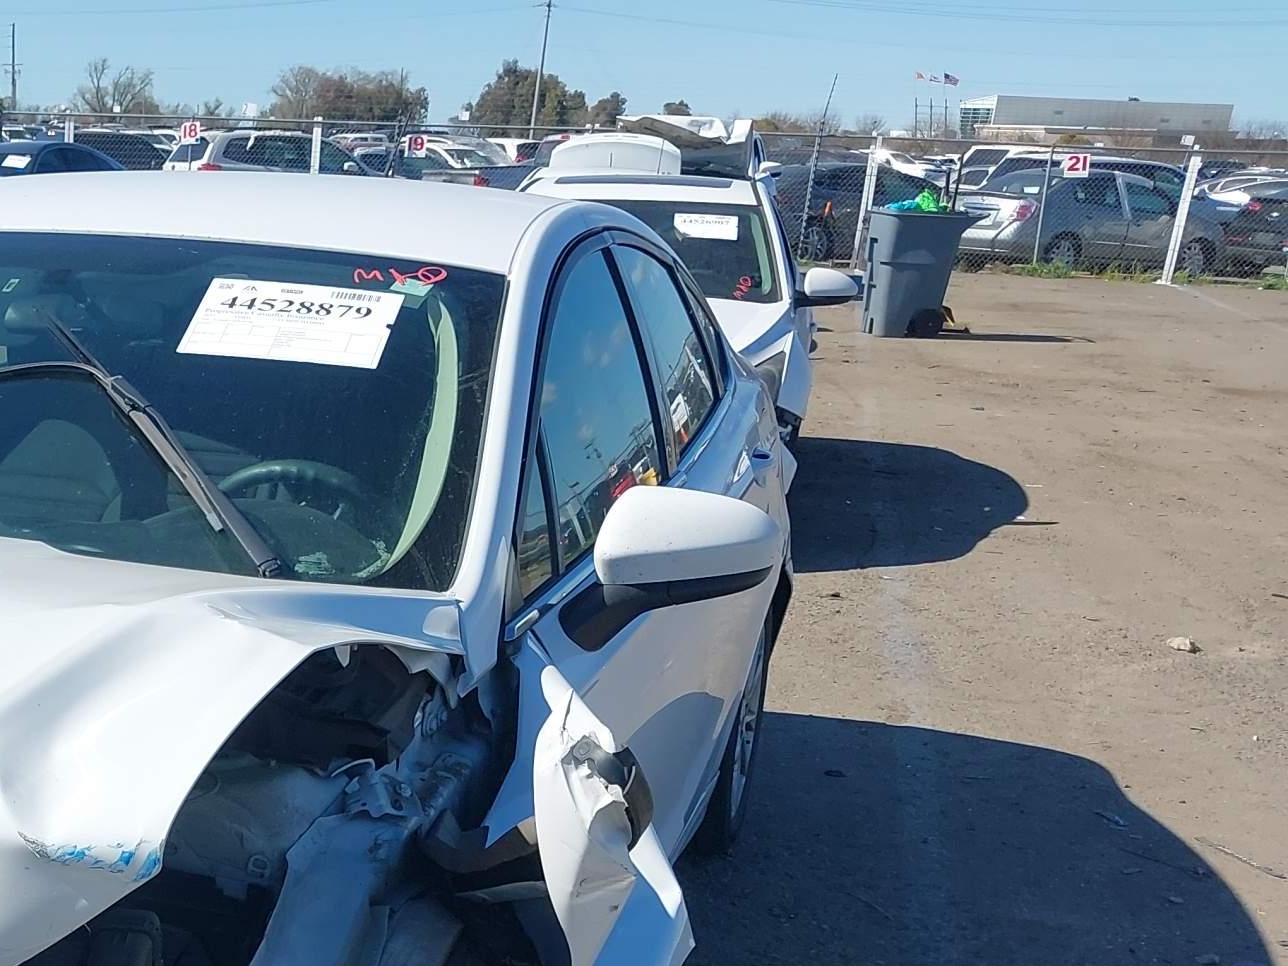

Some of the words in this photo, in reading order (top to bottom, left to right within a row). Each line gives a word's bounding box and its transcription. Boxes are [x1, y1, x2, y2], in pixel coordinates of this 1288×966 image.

[183, 123, 198, 139] 18
[408, 136, 425, 151] 19
[1066, 155, 1089, 171] 21
[220, 295, 373, 320] 44528879
